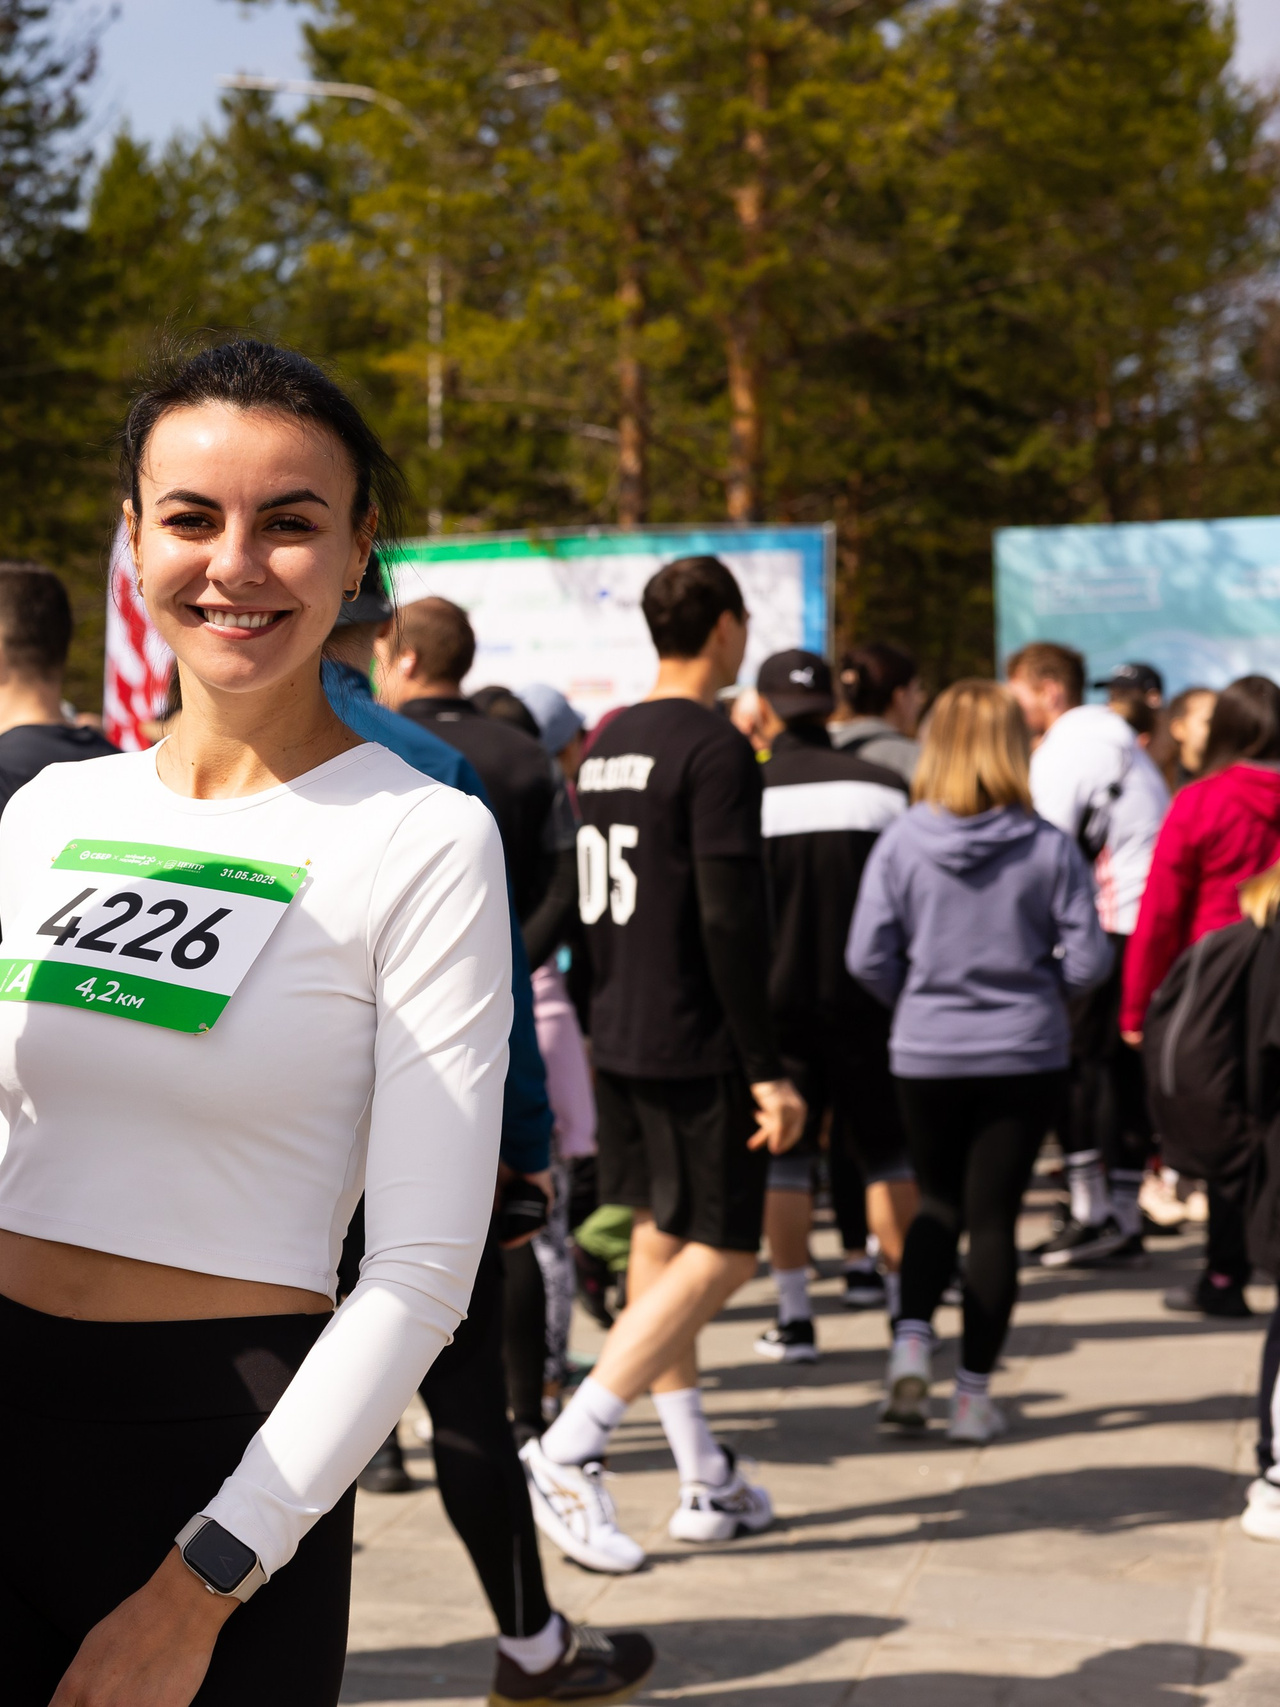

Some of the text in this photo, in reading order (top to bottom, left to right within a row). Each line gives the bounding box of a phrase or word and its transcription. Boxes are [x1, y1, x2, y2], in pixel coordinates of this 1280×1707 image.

[176, 861, 205, 871] ЦЕНТР
[220, 868, 277, 885] 31.05.2025
[576, 823, 639, 926] 05
[36, 888, 233, 970] 4226
[4, 962, 34, 993] А
[75, 977, 120, 1003] 4,2
